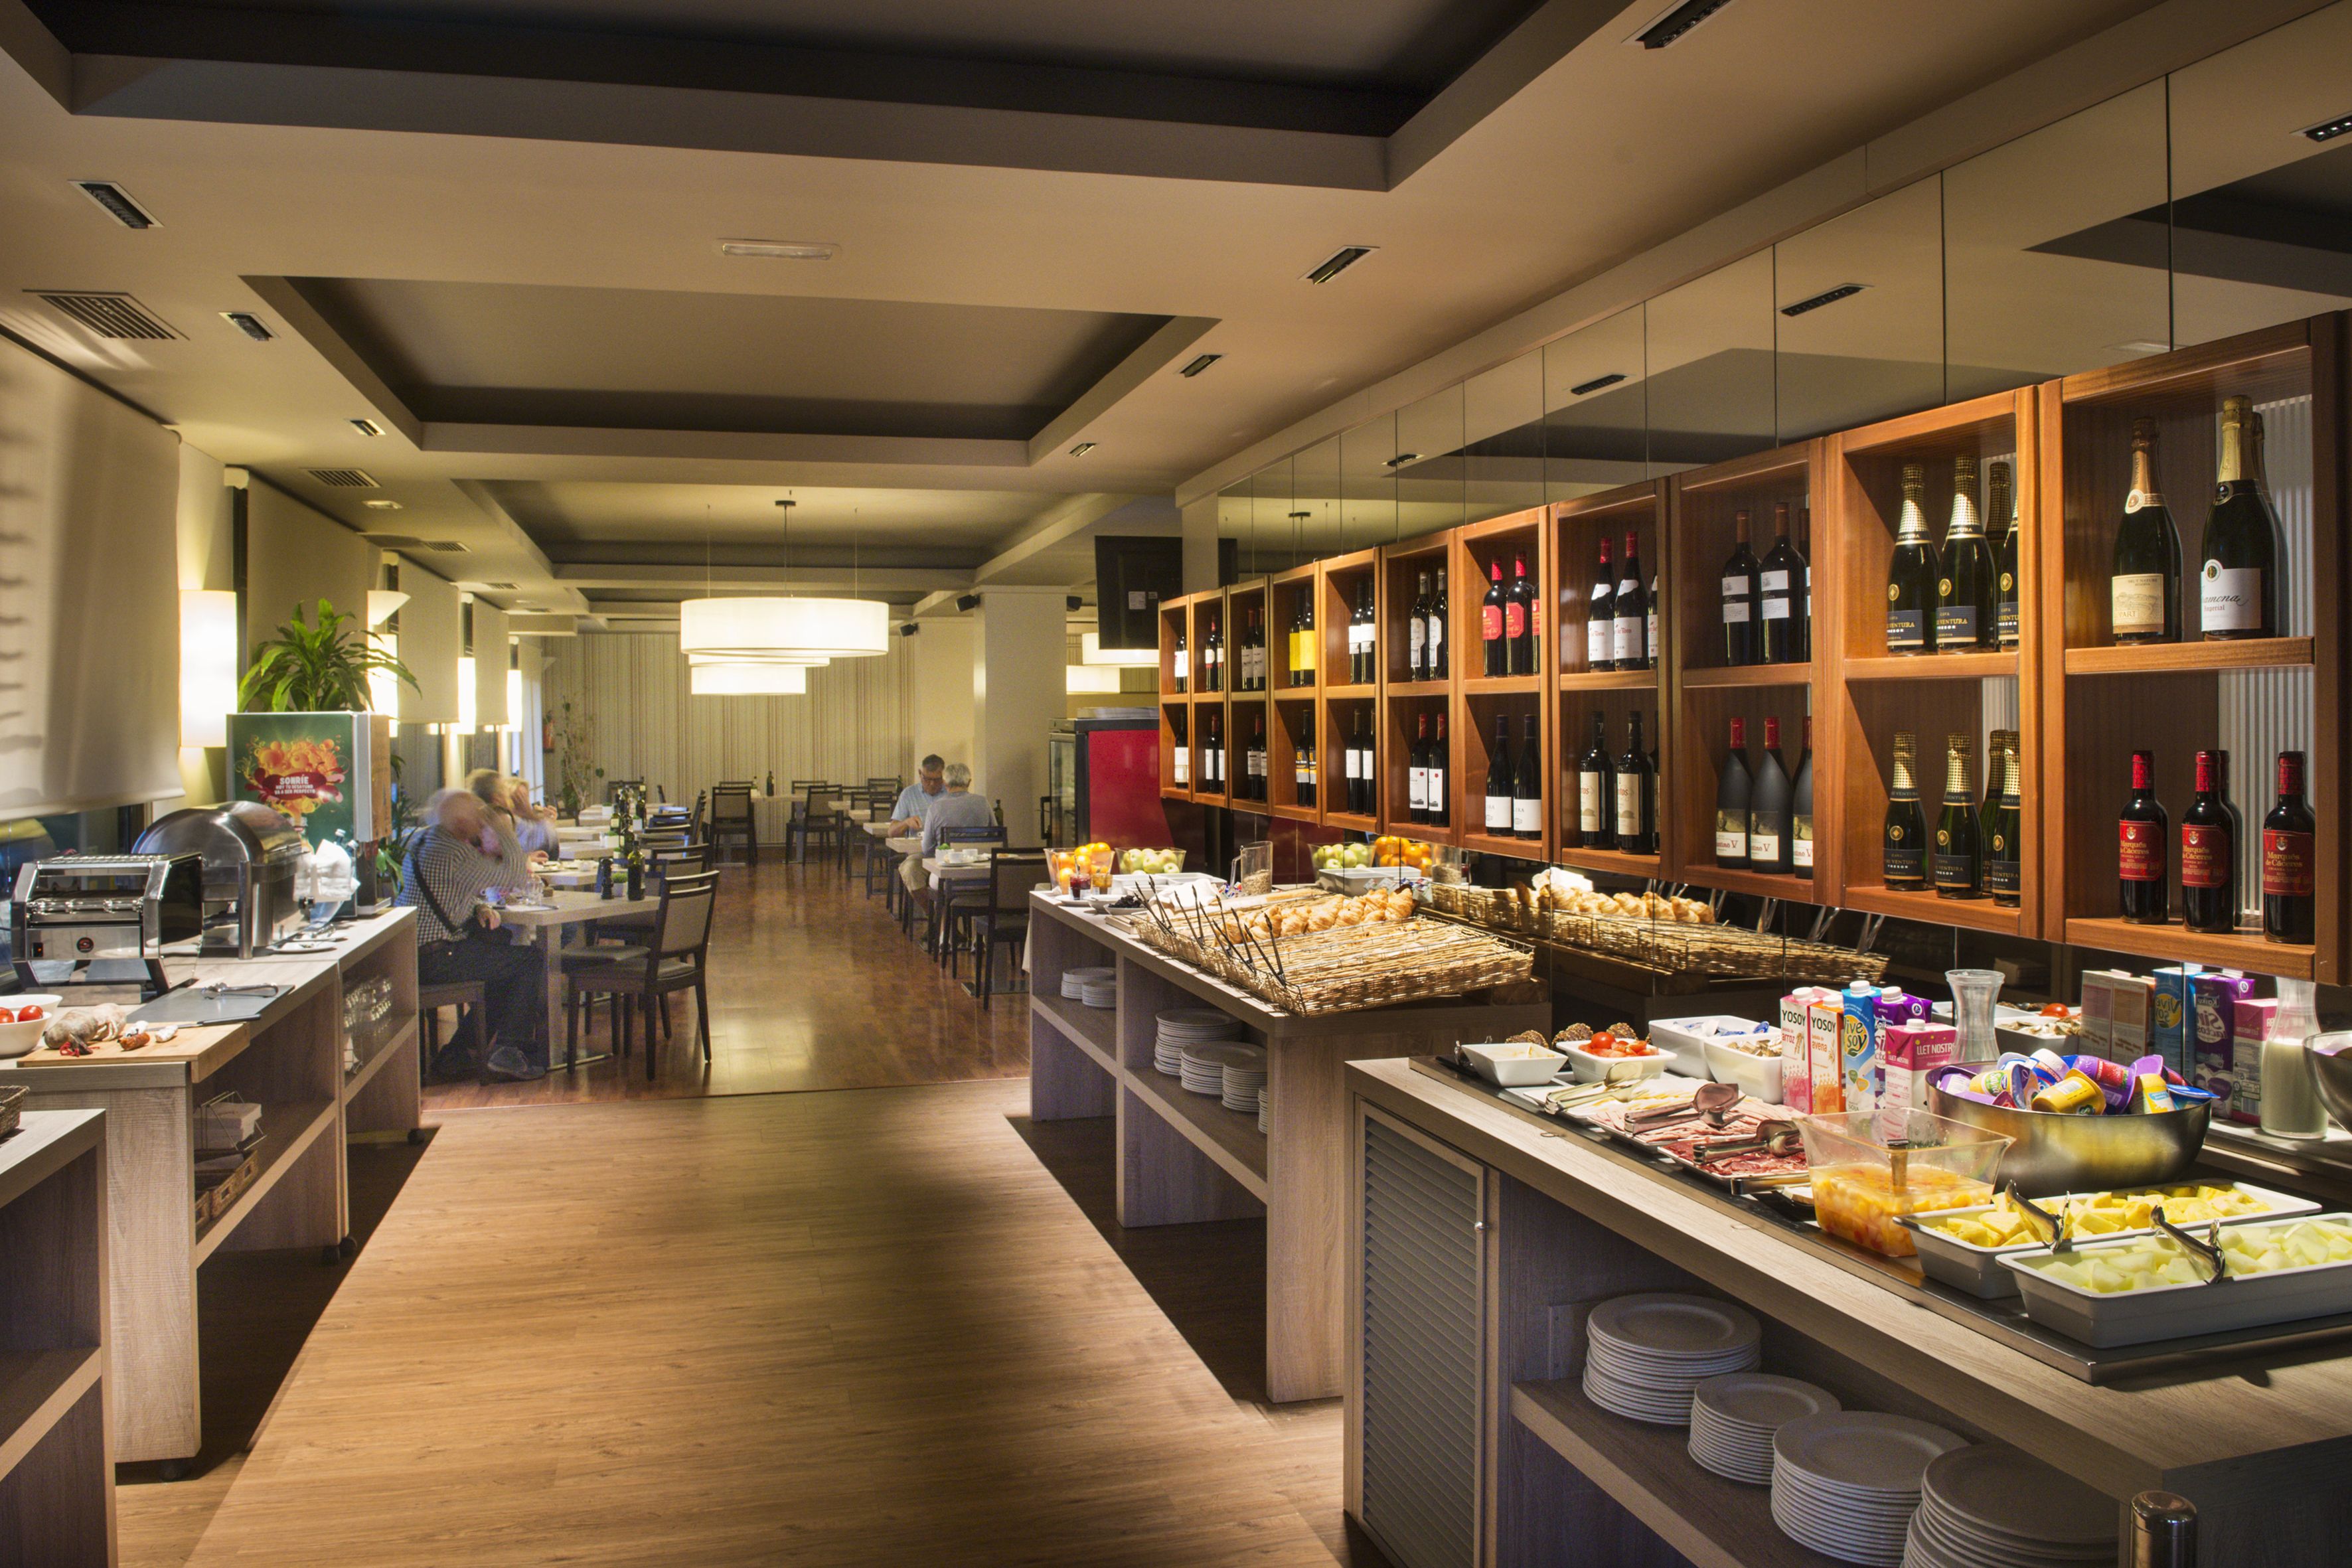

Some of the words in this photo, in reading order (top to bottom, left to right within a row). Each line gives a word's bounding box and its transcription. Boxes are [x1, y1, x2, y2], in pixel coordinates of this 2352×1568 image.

[2203, 593, 2249, 606] amona
[2267, 851, 2300, 861] Marqués
[1782, 1010, 1806, 1026] YOSOY
[1811, 1016, 1836, 1033] YOSOY
[1845, 1020, 1863, 1034] ive
[1782, 1033, 1795, 1044] arroz
[1847, 1034, 1867, 1052] soy
[1812, 1041, 1827, 1052] avena
[1917, 1044, 1930, 1056] LLET
